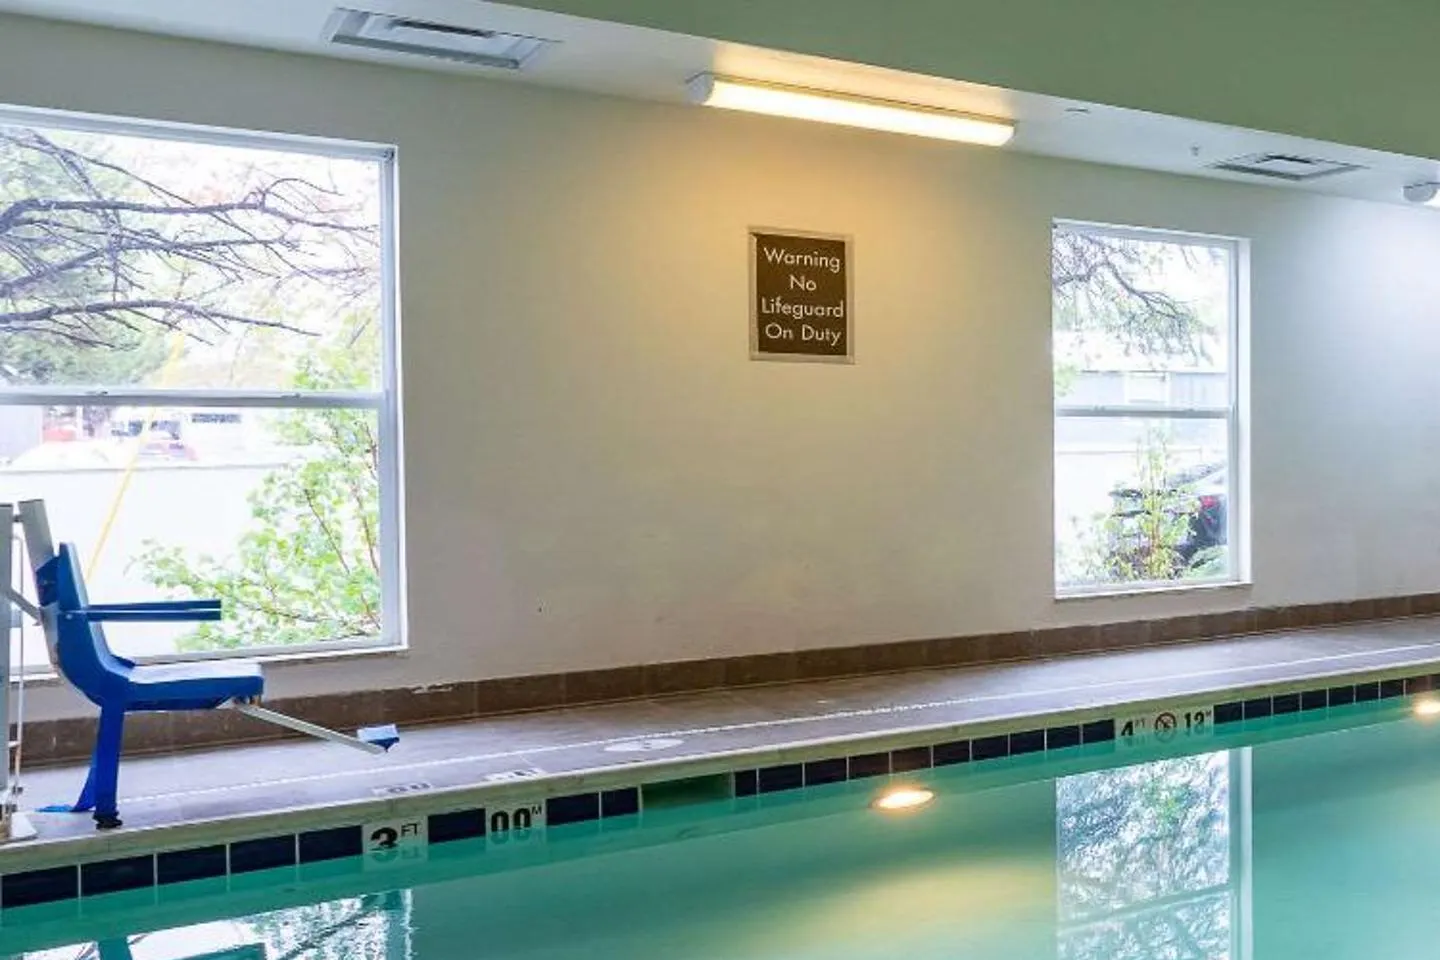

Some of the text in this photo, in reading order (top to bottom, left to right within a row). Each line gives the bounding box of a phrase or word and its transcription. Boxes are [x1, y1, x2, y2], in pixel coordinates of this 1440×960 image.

[763, 246, 842, 273] Warning
[788, 274, 817, 291] No
[761, 296, 844, 320] Lifeguard
[765, 322, 842, 346] On Duty
